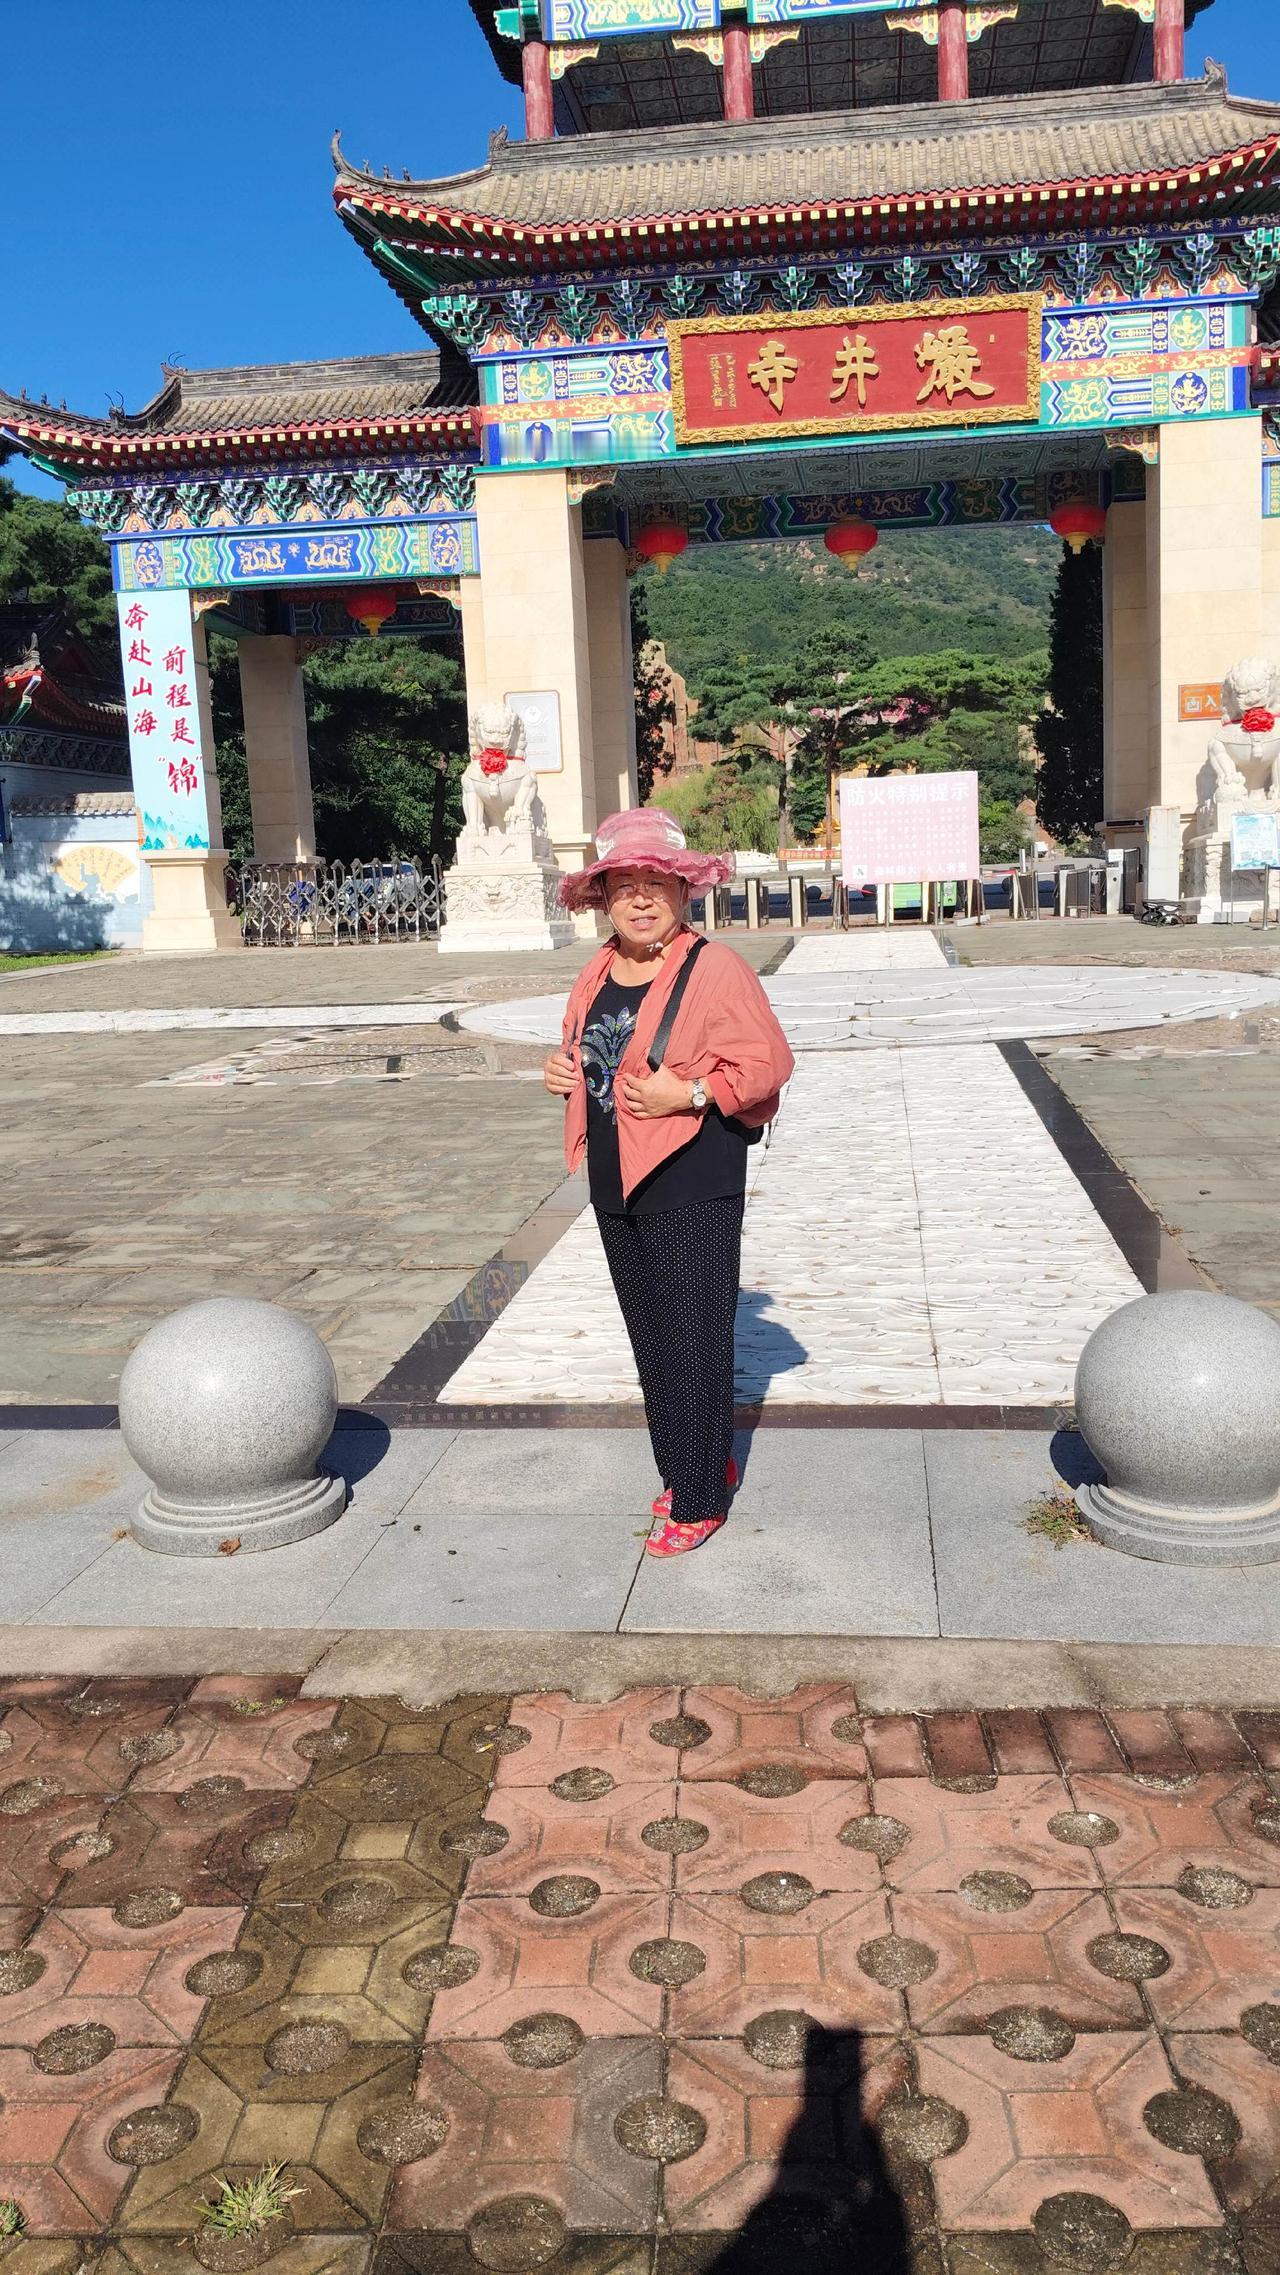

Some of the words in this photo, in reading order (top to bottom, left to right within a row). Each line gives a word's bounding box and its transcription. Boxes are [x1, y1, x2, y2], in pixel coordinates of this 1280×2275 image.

[125, 602, 158, 737] 奔赴山海
[847, 782, 969, 806] 防火特别提示
